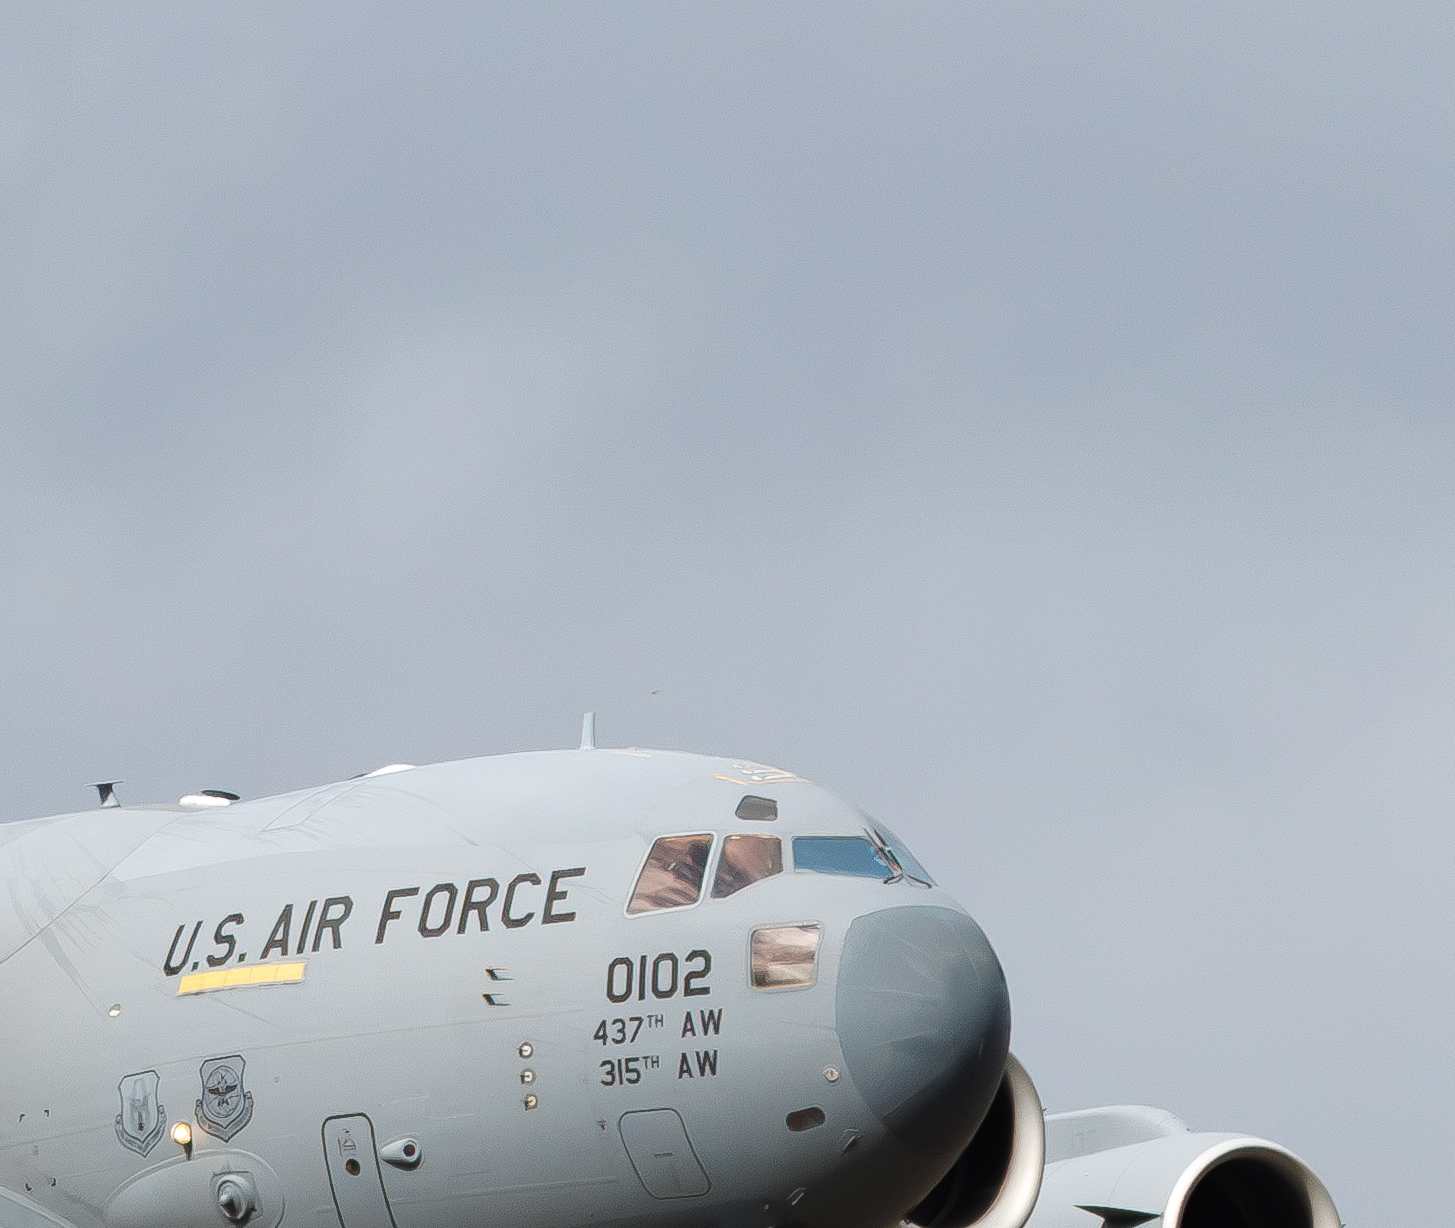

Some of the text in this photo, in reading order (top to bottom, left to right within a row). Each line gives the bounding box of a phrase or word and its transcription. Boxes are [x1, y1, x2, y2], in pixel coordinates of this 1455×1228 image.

[163, 867, 587, 977] U.S. AIR FORCE
[606, 949, 712, 1004] 0102
[593, 1008, 723, 1047] 437TH AW
[599, 1049, 719, 1087] 315TH AW
